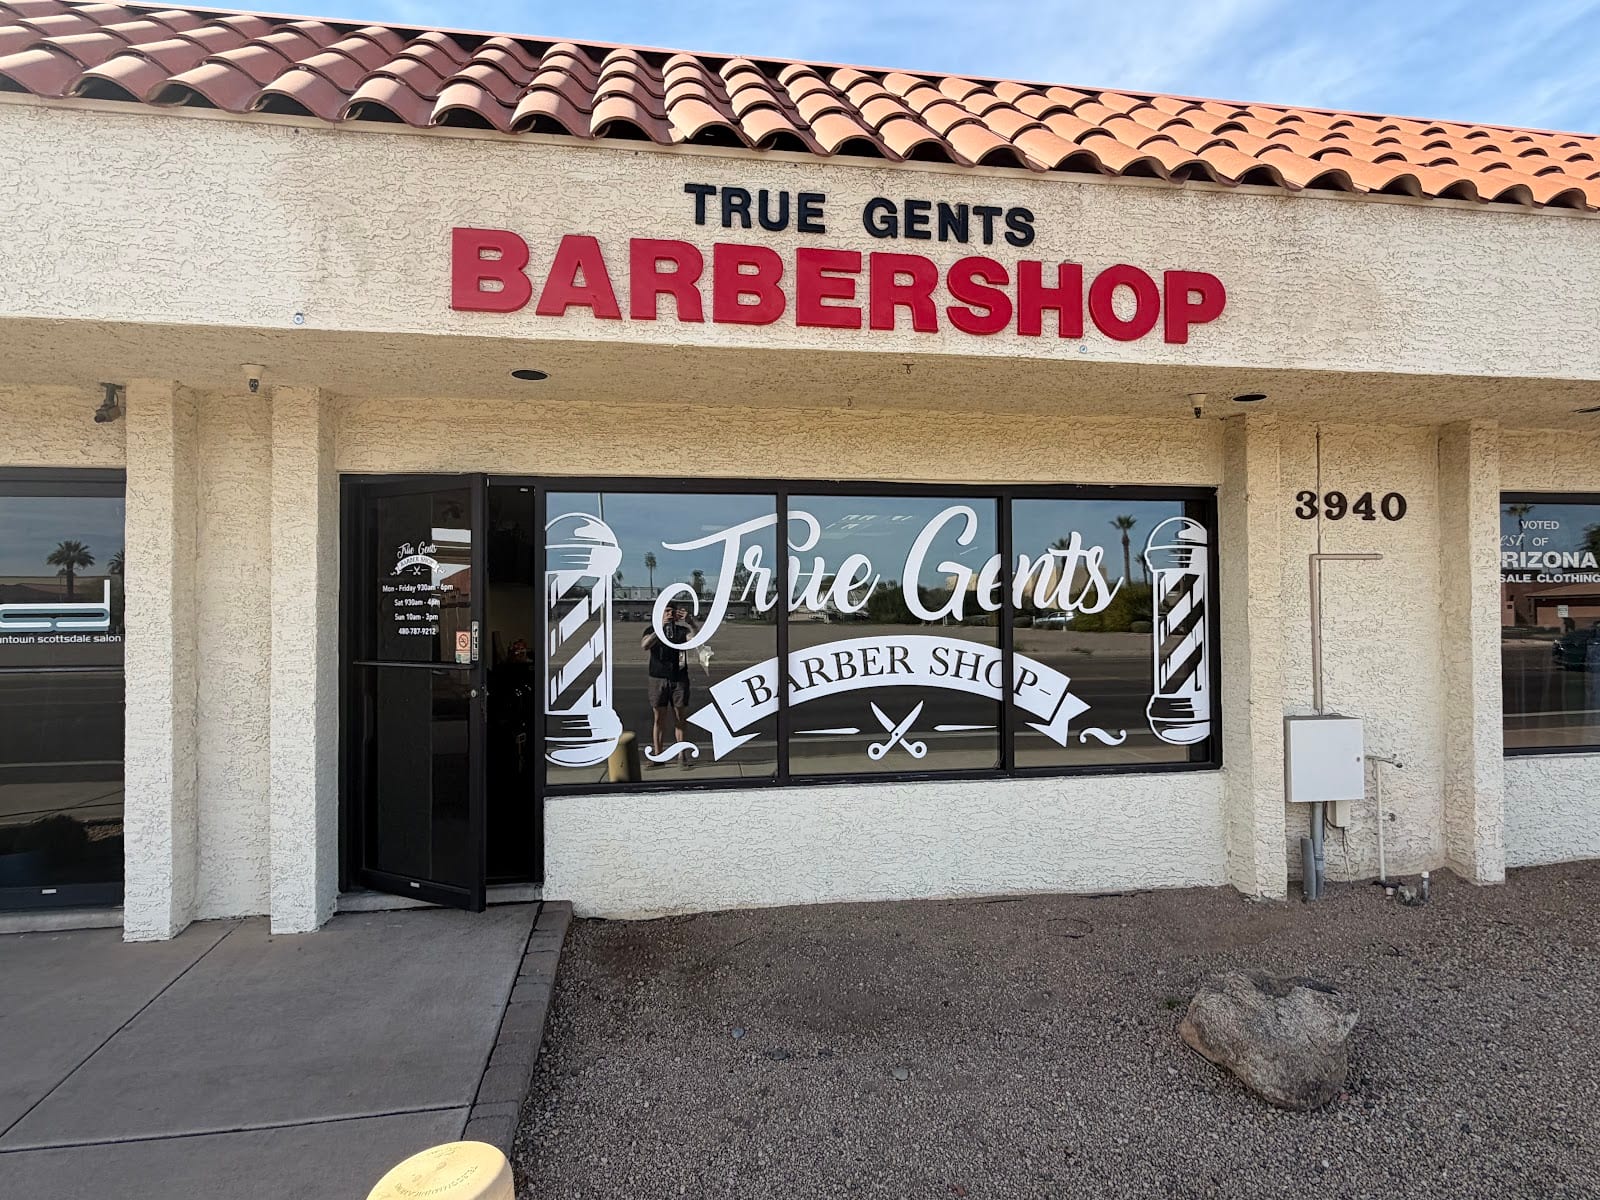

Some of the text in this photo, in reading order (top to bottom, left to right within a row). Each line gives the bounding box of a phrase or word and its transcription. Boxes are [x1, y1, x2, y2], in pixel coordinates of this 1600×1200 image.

[684, 183, 1036, 247] TRUE GENTS
[452, 227, 1227, 344] BARBERSHOP
[1295, 490, 1407, 521] 3940
[1520, 520, 1560, 530] VOTED
[1532, 537, 1550, 547] OF
[397, 542, 415, 559] True
[652, 505, 1125, 650] True Gents
[1536, 573, 1600, 584] CLOTHING
[398, 584, 416, 593] Friday
[416, 583, 436, 591] 930am
[440, 583, 453, 593] 6pm
[394, 598, 404, 606] Sat
[404, 598, 423, 606] 930am
[394, 613, 405, 621] Sun
[406, 612, 421, 620] 10am
[425, 612, 439, 622] 3pm
[37, 634, 92, 644] scottsdale
[93, 633, 122, 643] salon
